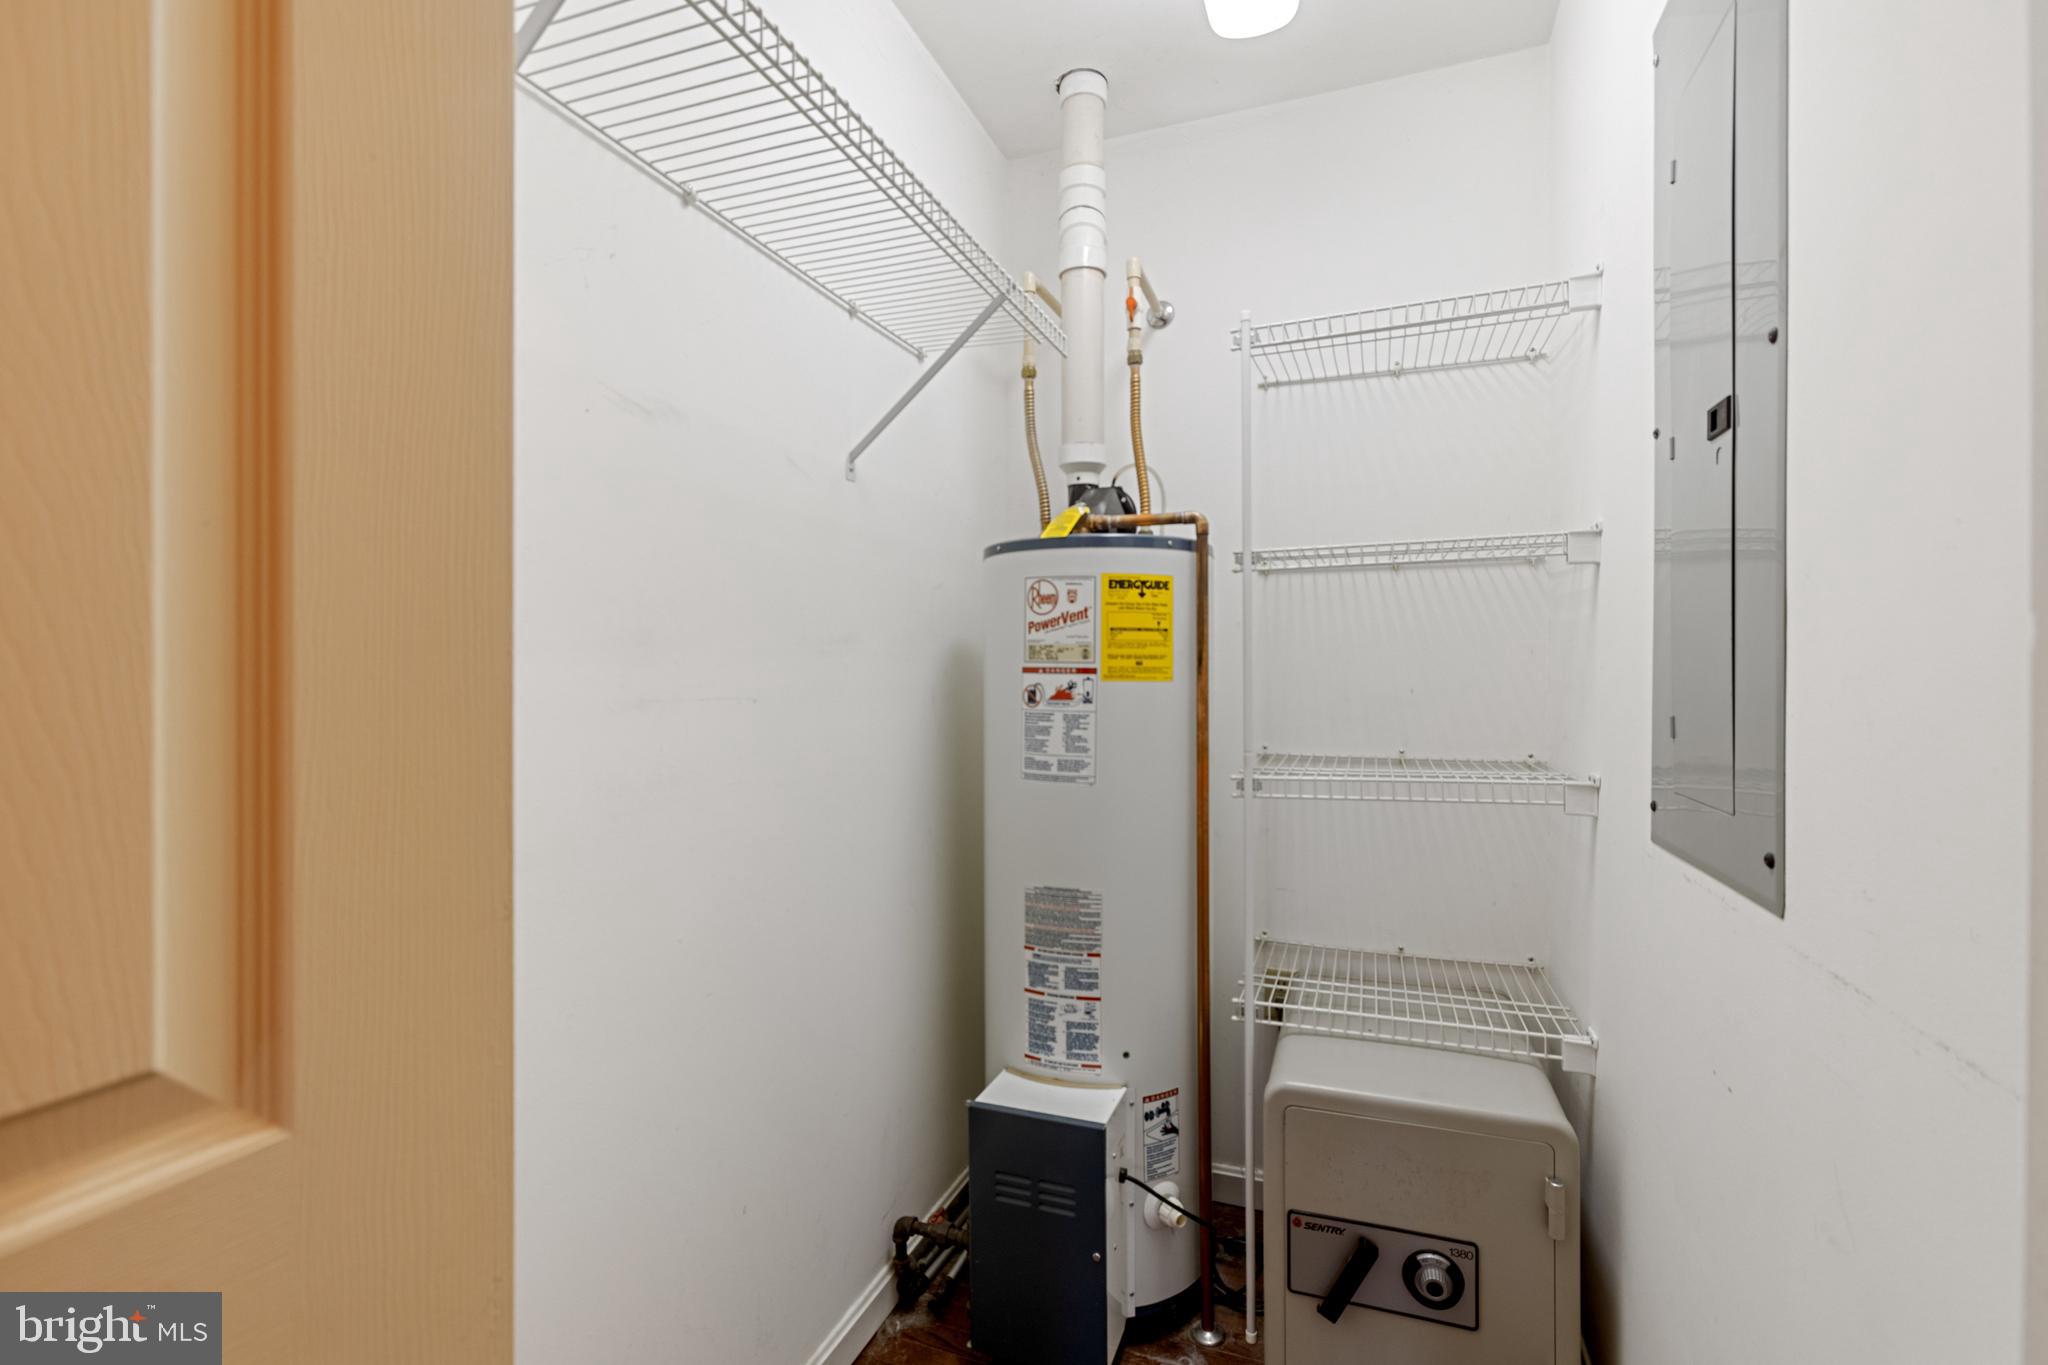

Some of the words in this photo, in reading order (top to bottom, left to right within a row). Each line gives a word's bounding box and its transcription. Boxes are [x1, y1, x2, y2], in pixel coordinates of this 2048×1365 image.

[1028, 606, 1089, 634] PowerVent
[1303, 1221, 1347, 1236] SENTRY
[1449, 1247, 1474, 1261] 1380
